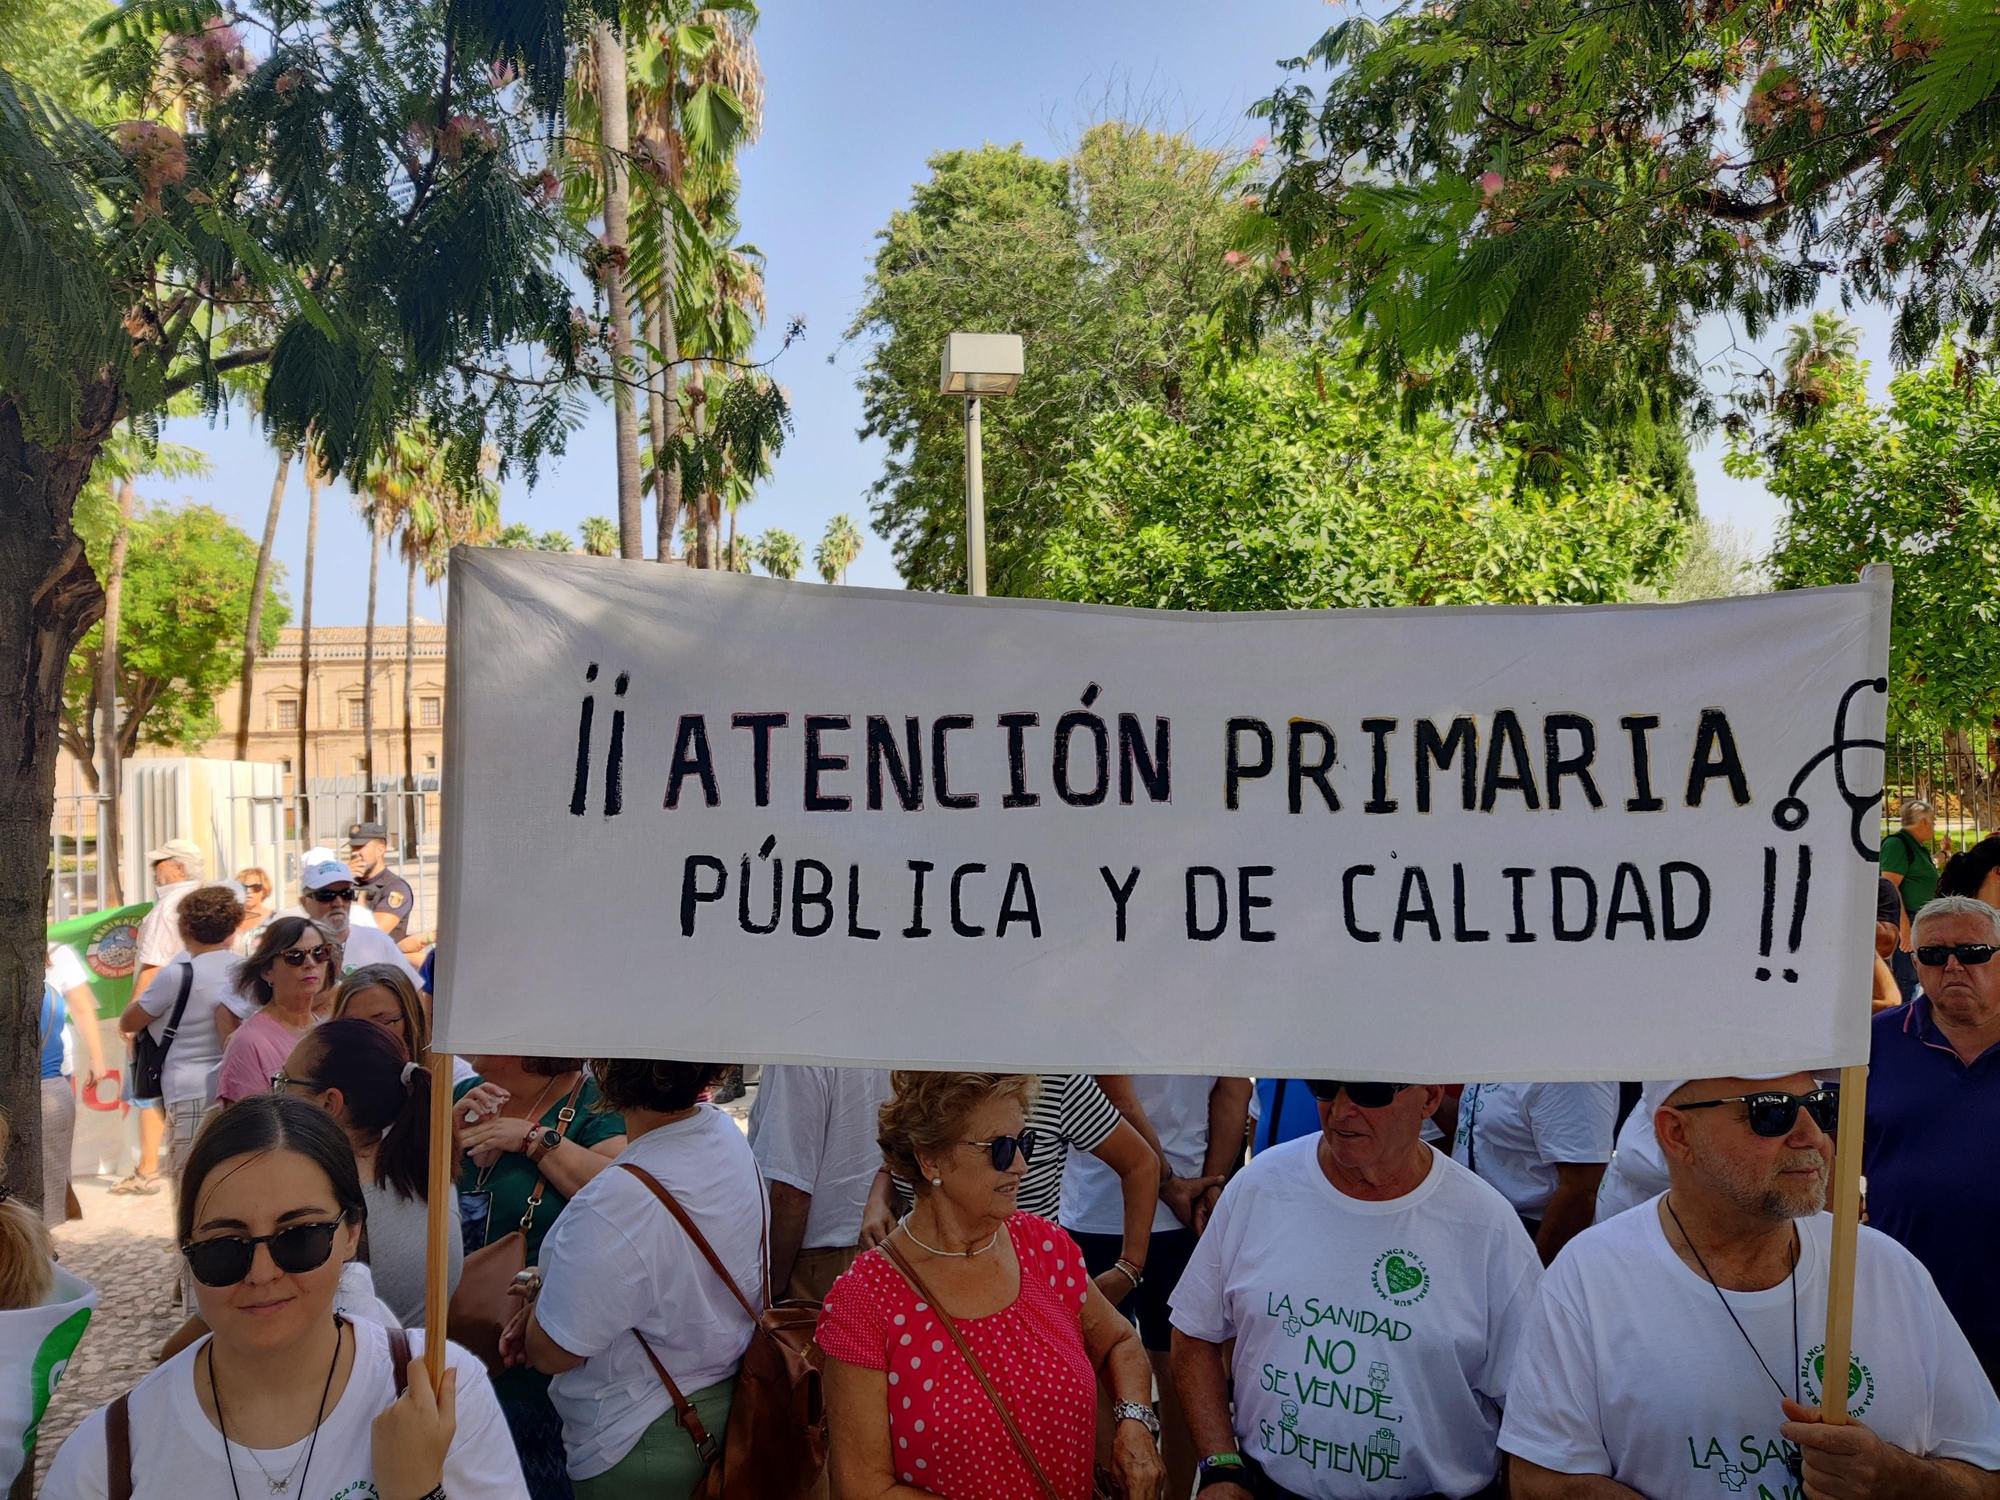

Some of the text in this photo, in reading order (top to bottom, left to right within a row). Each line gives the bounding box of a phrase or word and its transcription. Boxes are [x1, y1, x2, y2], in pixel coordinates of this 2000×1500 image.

[663, 681, 1172, 812] ATENCIÓN
[1224, 706, 1753, 815] PRIMARIA
[680, 834, 1042, 940] PÚBLICA
[1099, 865, 1141, 943] Y
[1185, 865, 1277, 943] DE
[1341, 860, 1712, 945] CALIDAD
[1371, 1248, 1430, 1307] MAREA BLANCA DE LA SIERRA SUR
[1267, 1291, 1412, 1342] LA SANIDAD
[1304, 1335, 1356, 1375] NO
[1260, 1363, 1403, 1423] SE VENDE,
[1860, 1366, 1875, 1406] SIERRA
[1259, 1419, 1407, 1482] SE DEFIENDE.
[1687, 1436, 1730, 1470] LA
[351, 1480, 367, 1491] DE
